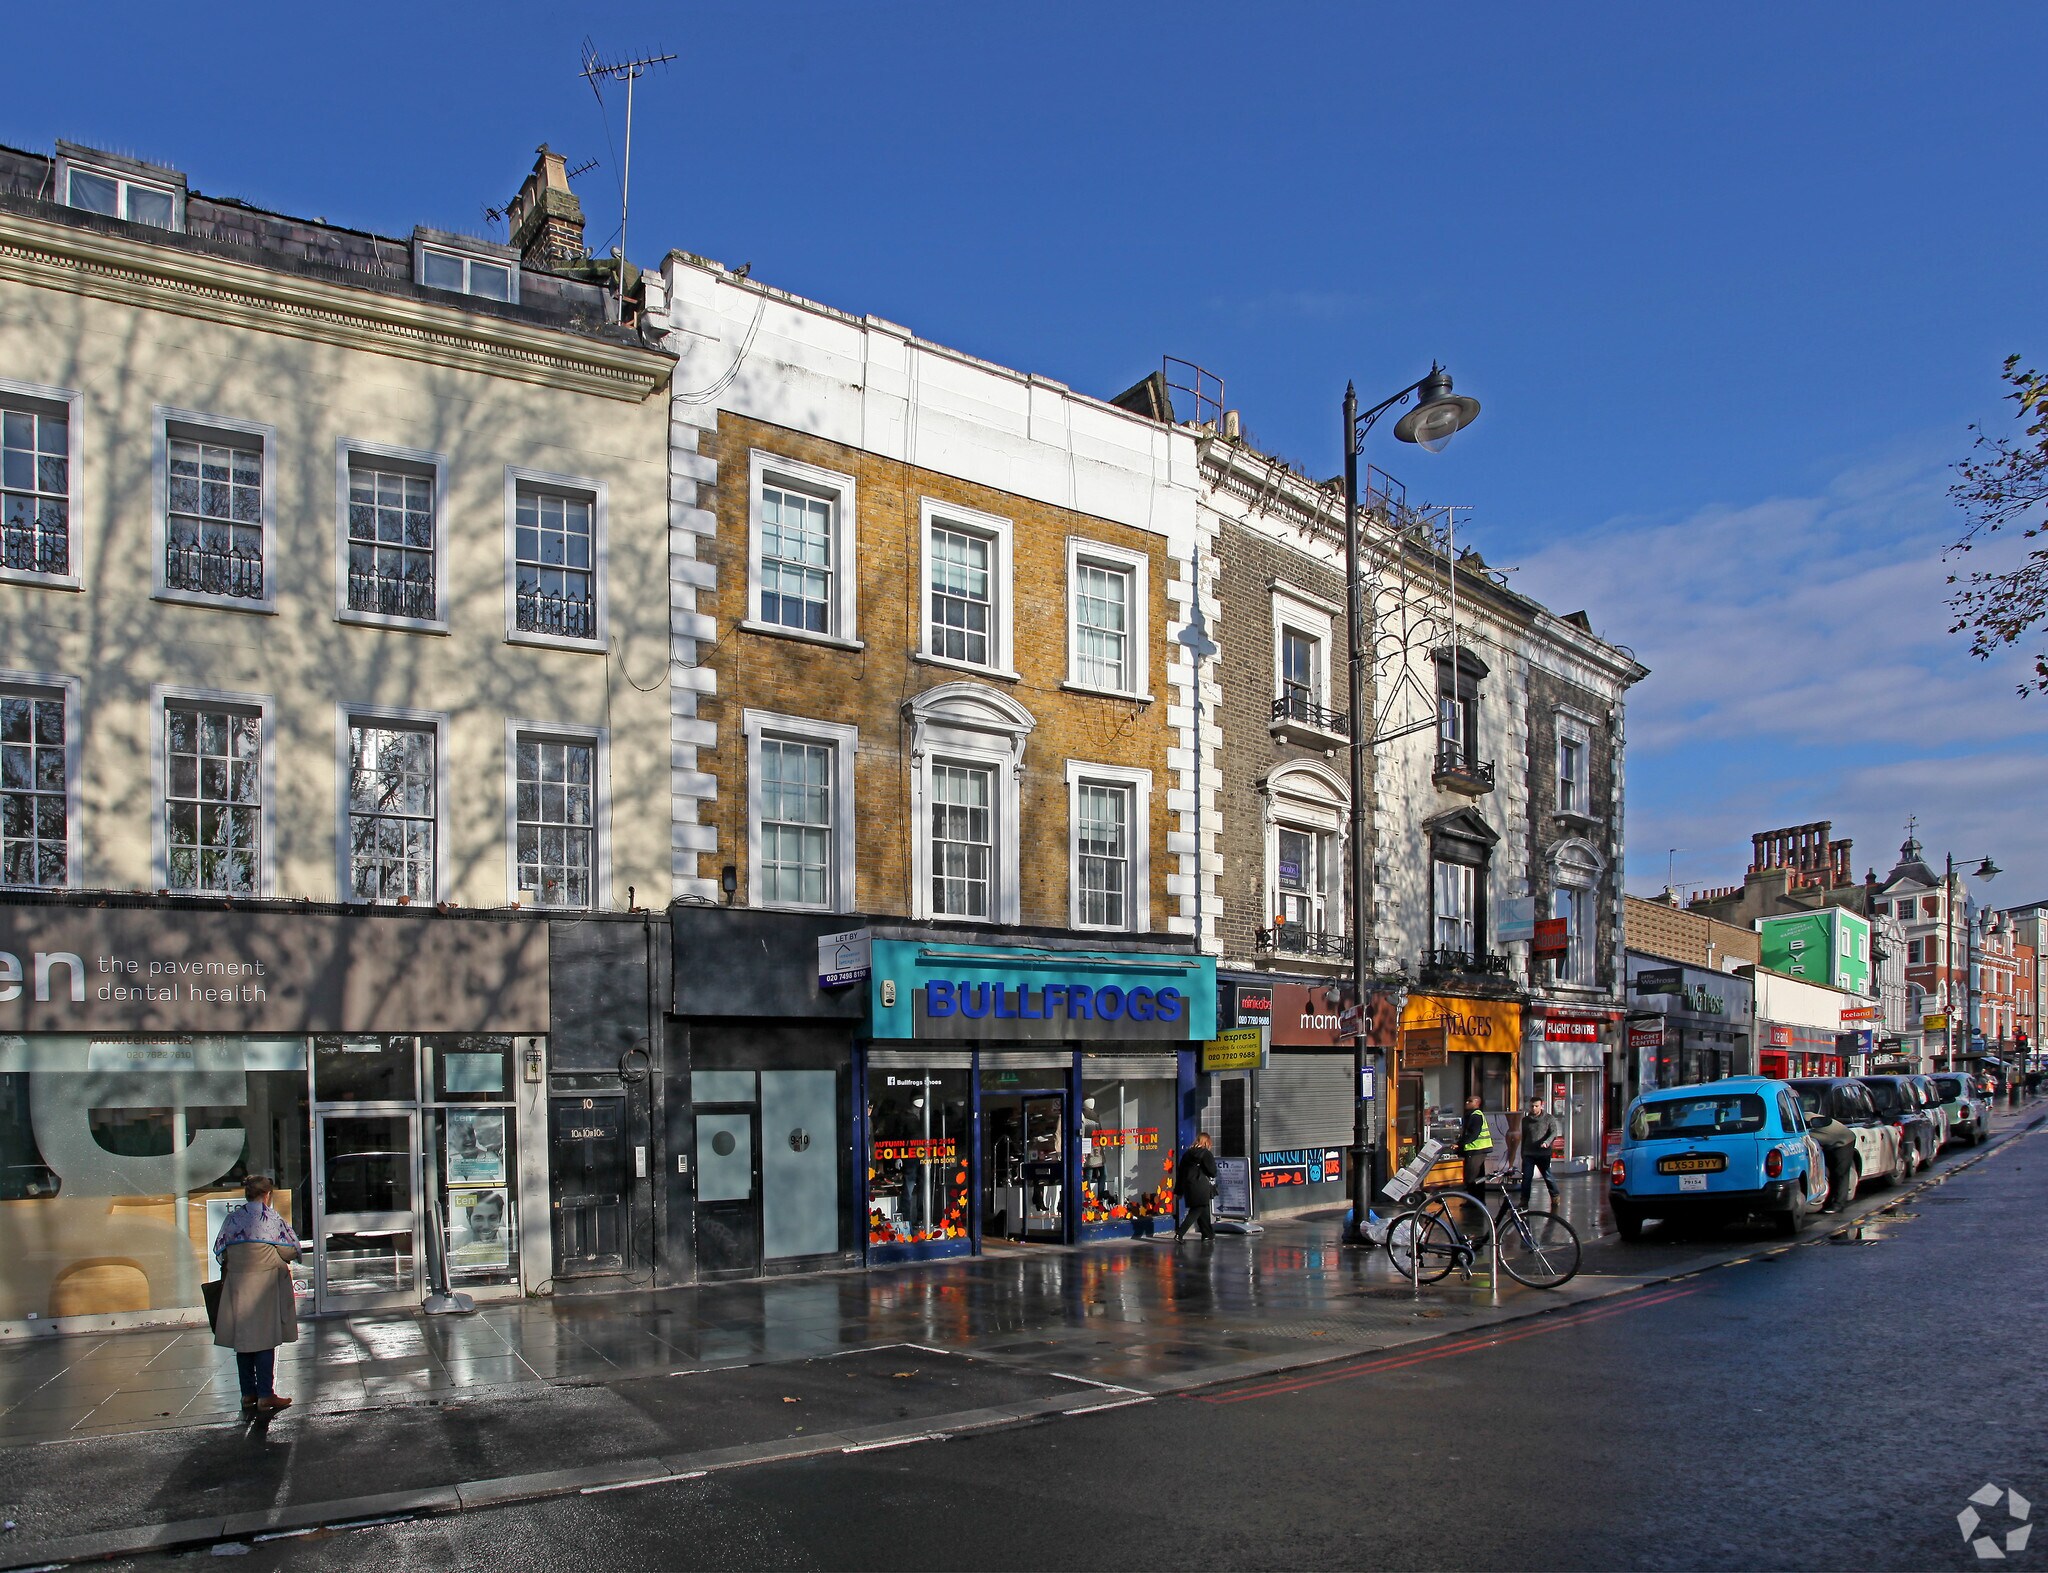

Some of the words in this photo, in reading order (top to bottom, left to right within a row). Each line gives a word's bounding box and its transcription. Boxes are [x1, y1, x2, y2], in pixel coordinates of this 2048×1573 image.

[836, 934, 848, 942] LET
[849, 932, 858, 940] BY
[1536, 929, 1566, 946] Abode
[97, 955, 139, 973] the
[149, 959, 266, 977] pavement
[826, 974, 838, 982] 020
[839, 972, 852, 980] 7498
[853, 969, 866, 978] 8190
[1641, 977, 1676, 985] Waitrose
[97, 982, 178, 1001] dental
[190, 983, 267, 1002] health
[926, 980, 1182, 1022] BULLFROGS
[1241, 995, 1271, 1010] minicabs
[1842, 1010, 1870, 1018] Iceland
[1946, 1005, 1953, 1013] A
[1440, 1013, 1492, 1037] IMAGES
[1547, 1022, 1570, 1034] FLIGHT
[1571, 1023, 1595, 1035] CENTRE
[1224, 1032, 1256, 1042] express
[1631, 1033, 1660, 1041] FLIGHT
[1630, 1039, 1660, 1047] CENTRE
[126, 1051, 143, 1059] 020
[1208, 1053, 1221, 1061] 020
[1222, 1052, 1238, 1060] 7720
[582, 1099, 593, 1109] 10
[790, 1134, 809, 1145] 9-10
[874, 1140, 905, 1149] AUTUMN
[1092, 1134, 1158, 1147] COLLECTION
[874, 1146, 956, 1160] COLLECTION
[940, 1156, 956, 1164] store
[1667, 1160, 1695, 1170] LX53
[1698, 1159, 1718, 1168] BYY
[455, 1196, 475, 1205] ten
